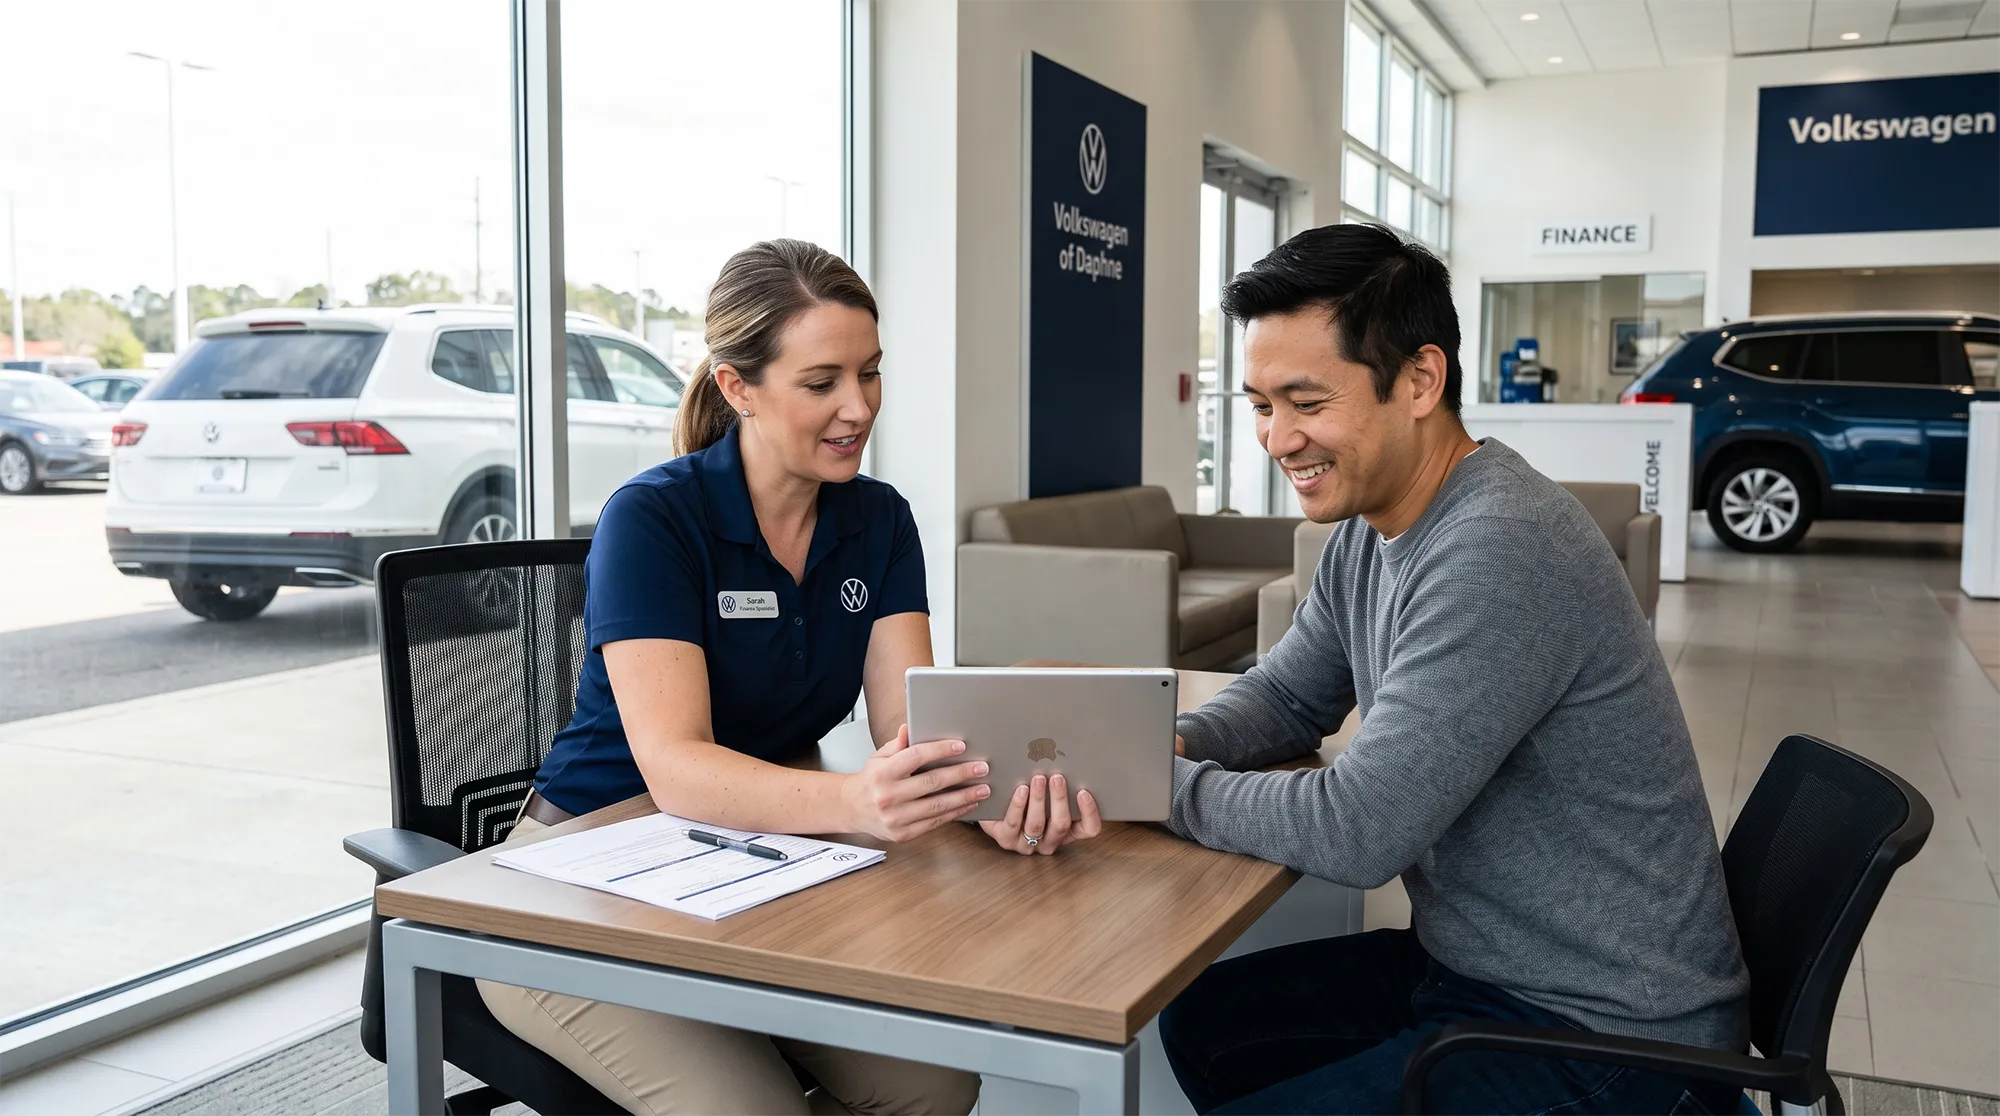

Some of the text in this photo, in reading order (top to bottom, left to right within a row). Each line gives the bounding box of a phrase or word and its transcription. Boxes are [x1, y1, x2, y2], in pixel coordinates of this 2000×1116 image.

[1789, 111, 1996, 144] Volkswagen
[1053, 201, 1129, 249] Volkswagen
[1542, 224, 1637, 246] FINANCE
[1059, 243, 1123, 282] of Daphne
[1645, 440, 1661, 514] ELCOME
